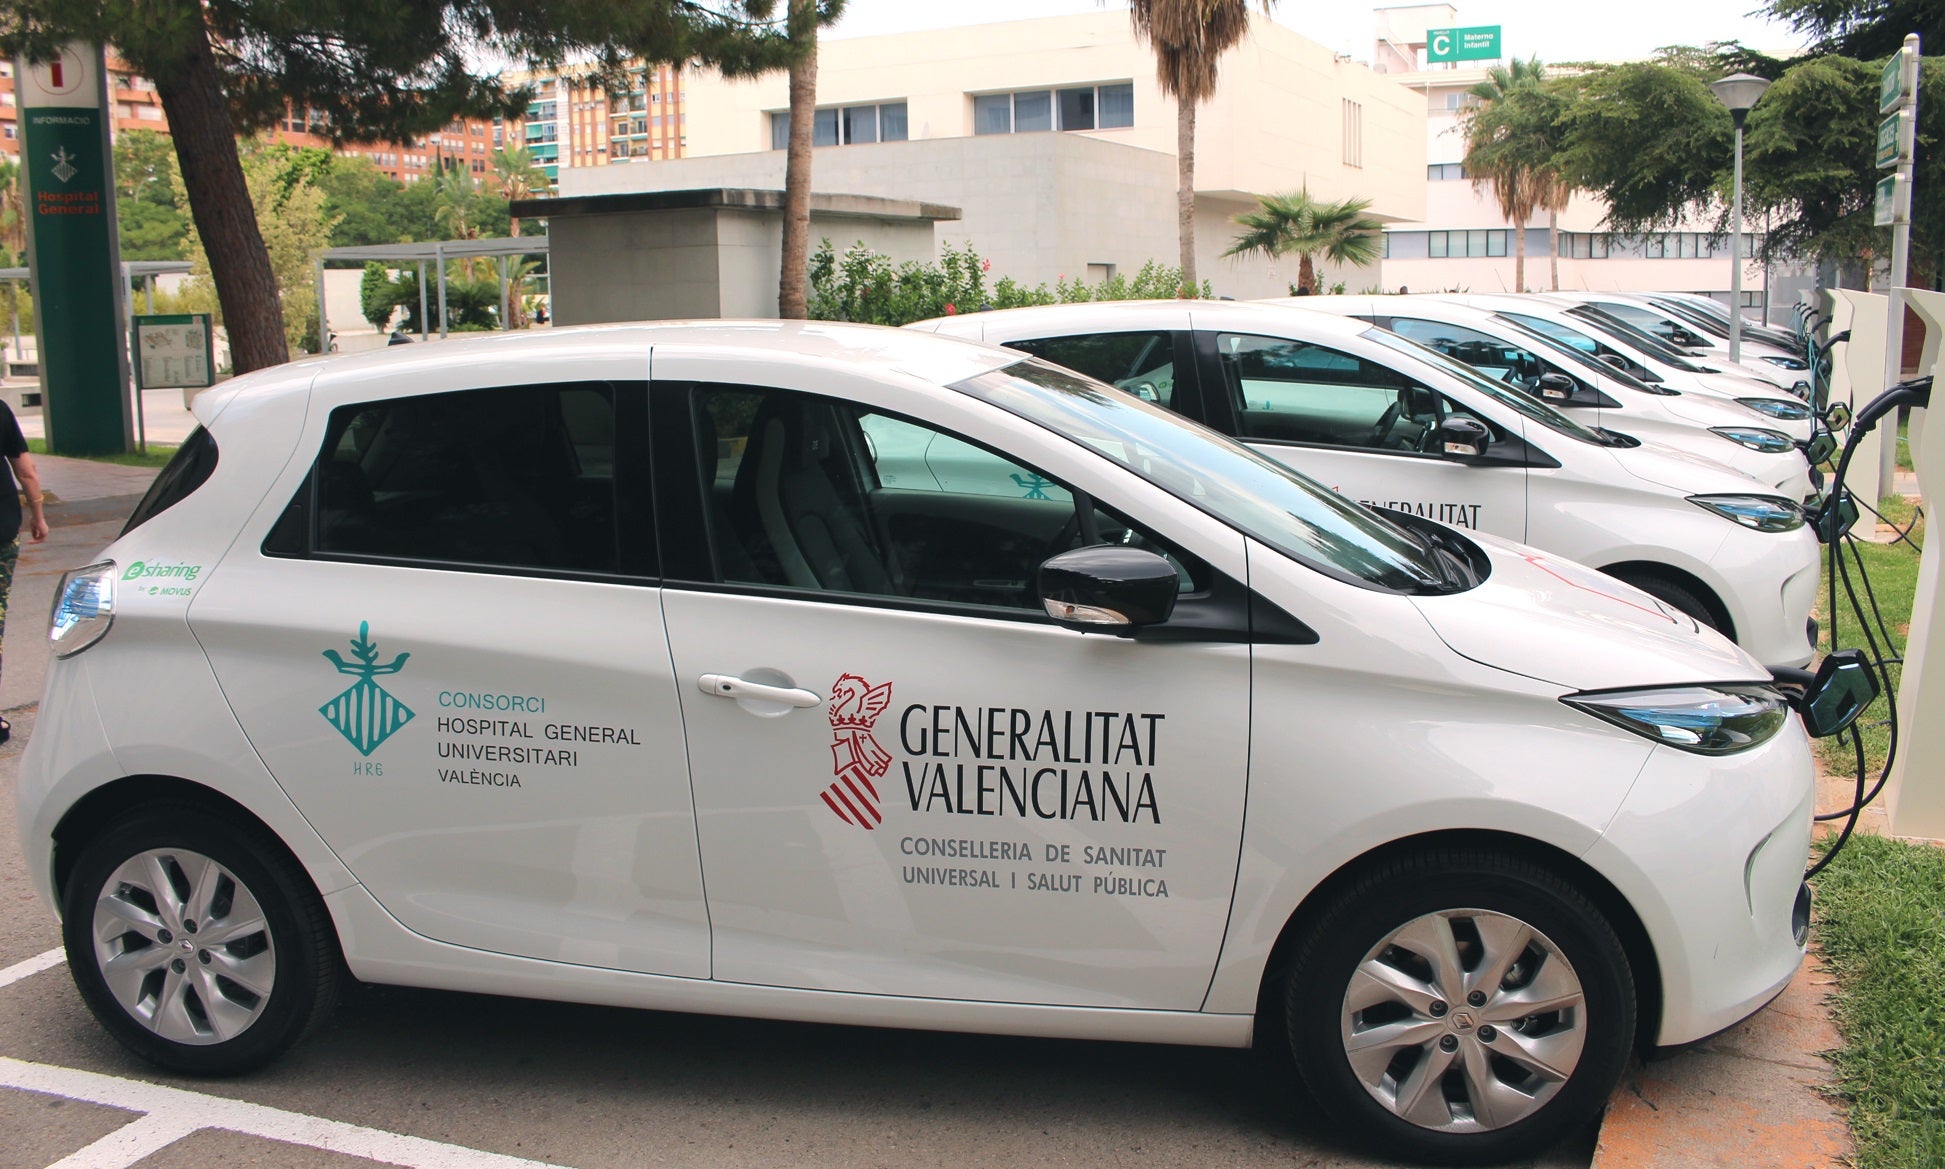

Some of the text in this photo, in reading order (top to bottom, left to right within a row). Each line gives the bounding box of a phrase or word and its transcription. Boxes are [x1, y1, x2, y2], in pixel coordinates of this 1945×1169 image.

[1433, 35, 1450, 56] C
[1464, 33, 1494, 41] Materno
[37, 191, 99, 204] Hospital
[38, 203, 99, 216] General
[160, 587, 192, 596] MOVUS
[438, 691, 546, 713] CONSORCI
[437, 717, 641, 745] HOSPITAL GENERAL
[900, 703, 1166, 766] GENERALITAT
[437, 742, 578, 767] UNIVERSITARI
[438, 768, 522, 788] VALÈNCIA
[902, 761, 1162, 824] VALENCIANA
[900, 836, 1166, 868] CONSELLERIA DE SANITAT
[903, 866, 1169, 898] UNIVERSAL I SALUT PÚBLICA
